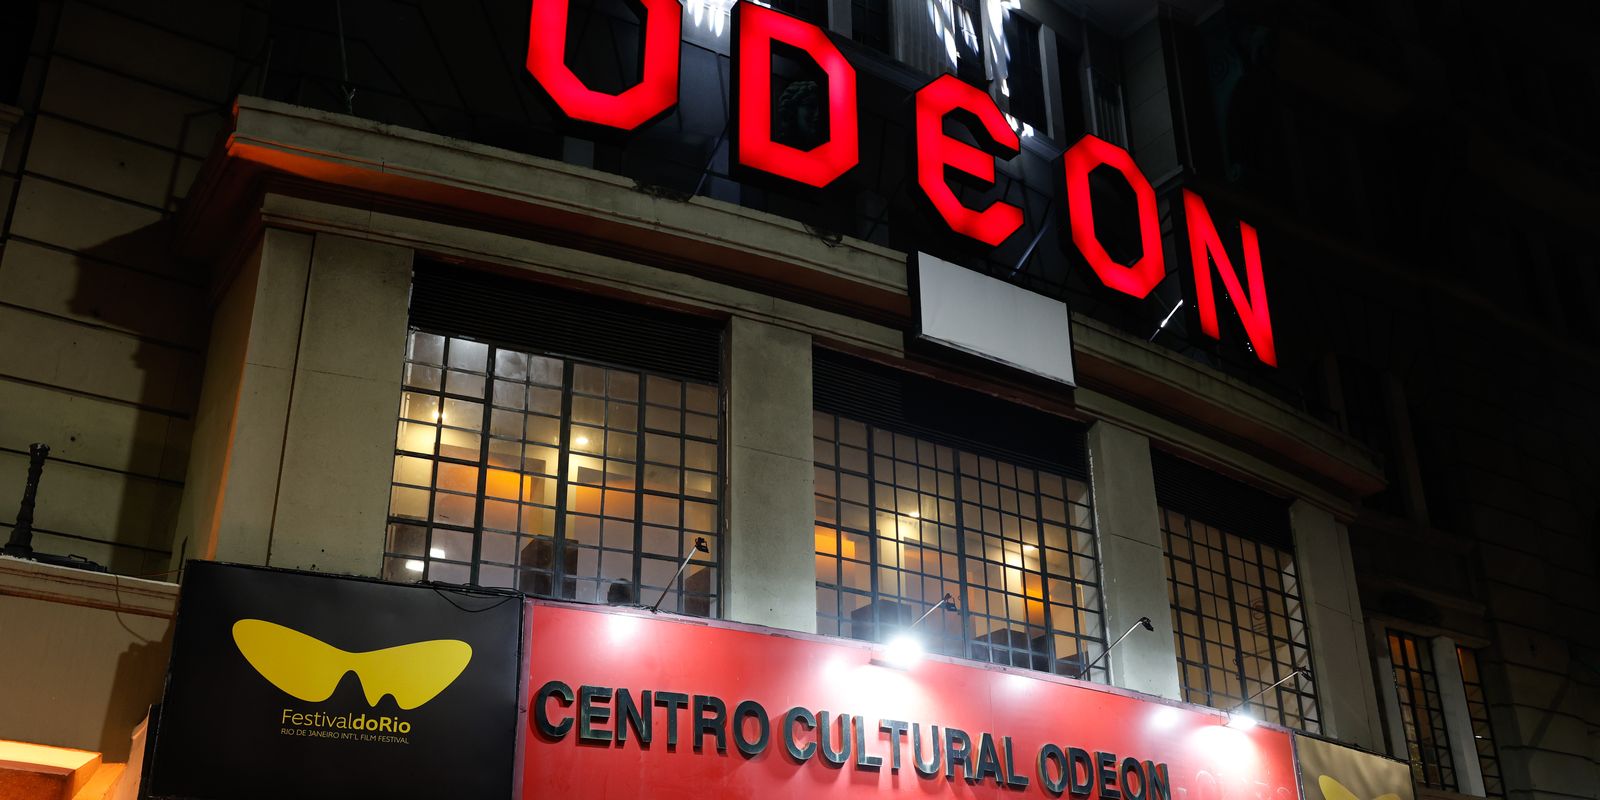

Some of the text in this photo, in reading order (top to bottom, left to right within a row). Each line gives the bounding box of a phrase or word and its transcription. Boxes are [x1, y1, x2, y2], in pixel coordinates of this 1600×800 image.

[525, 0, 1279, 368] ODEON
[280, 728, 295, 736] RIO
[296, 729, 307, 737] DE
[308, 730, 340, 739] JANEIRO
[341, 733, 359, 741] INT'L
[378, 735, 410, 745] FESTIVAL
[282, 708, 411, 734] FestivaldoRio
[533, 680, 771, 756] CENTRO
[784, 706, 1029, 788] CULTURAL
[1038, 743, 1172, 800] ODEON
